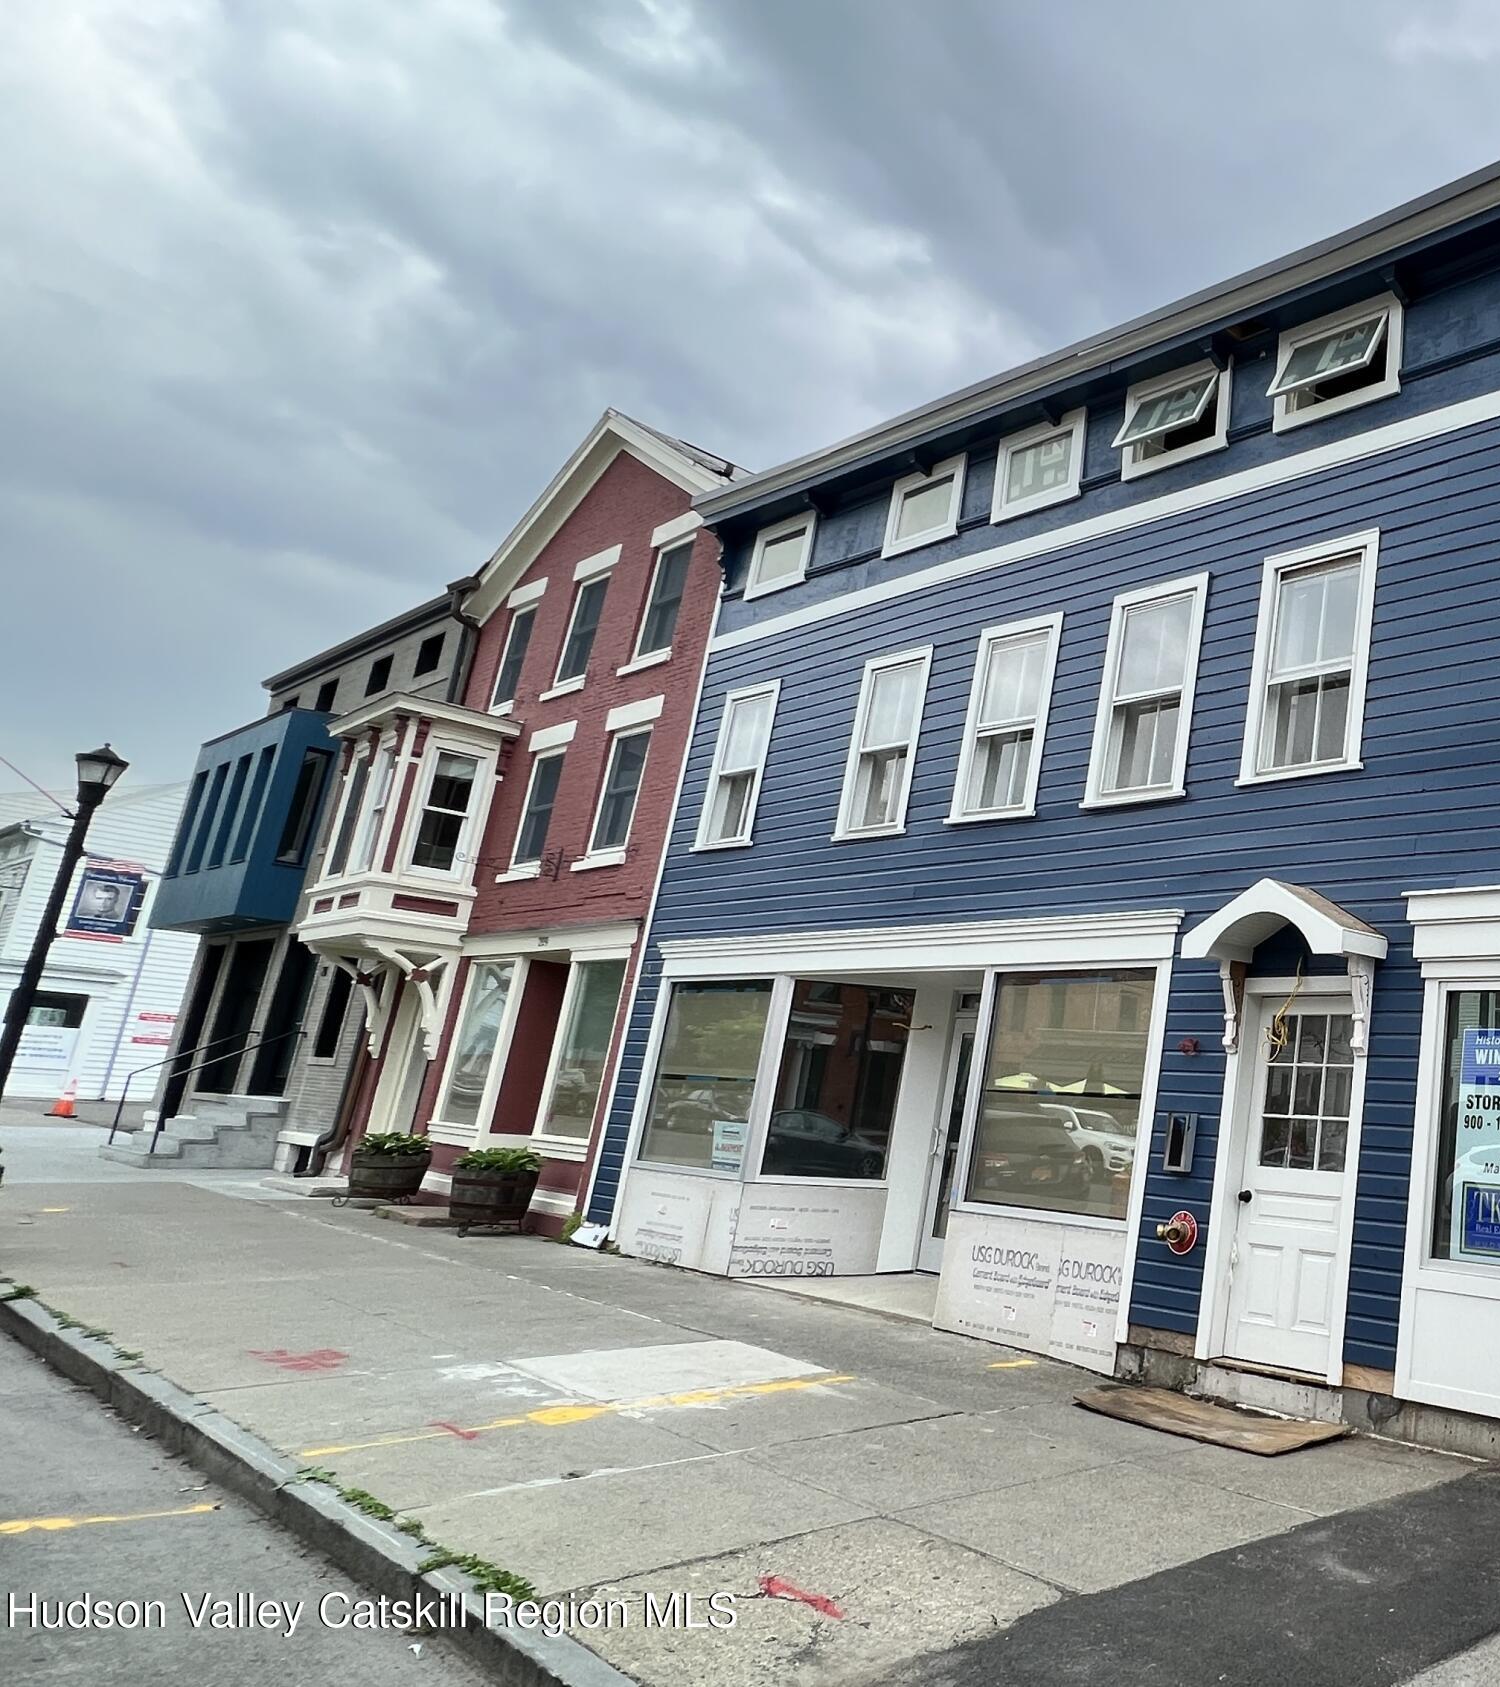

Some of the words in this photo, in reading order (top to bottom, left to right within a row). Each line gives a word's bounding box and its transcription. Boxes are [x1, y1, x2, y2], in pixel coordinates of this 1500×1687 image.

[1464, 1115, 1484, 1130] 900
[1476, 1224, 1492, 1233] Real
[972, 1245, 992, 1263] USG
